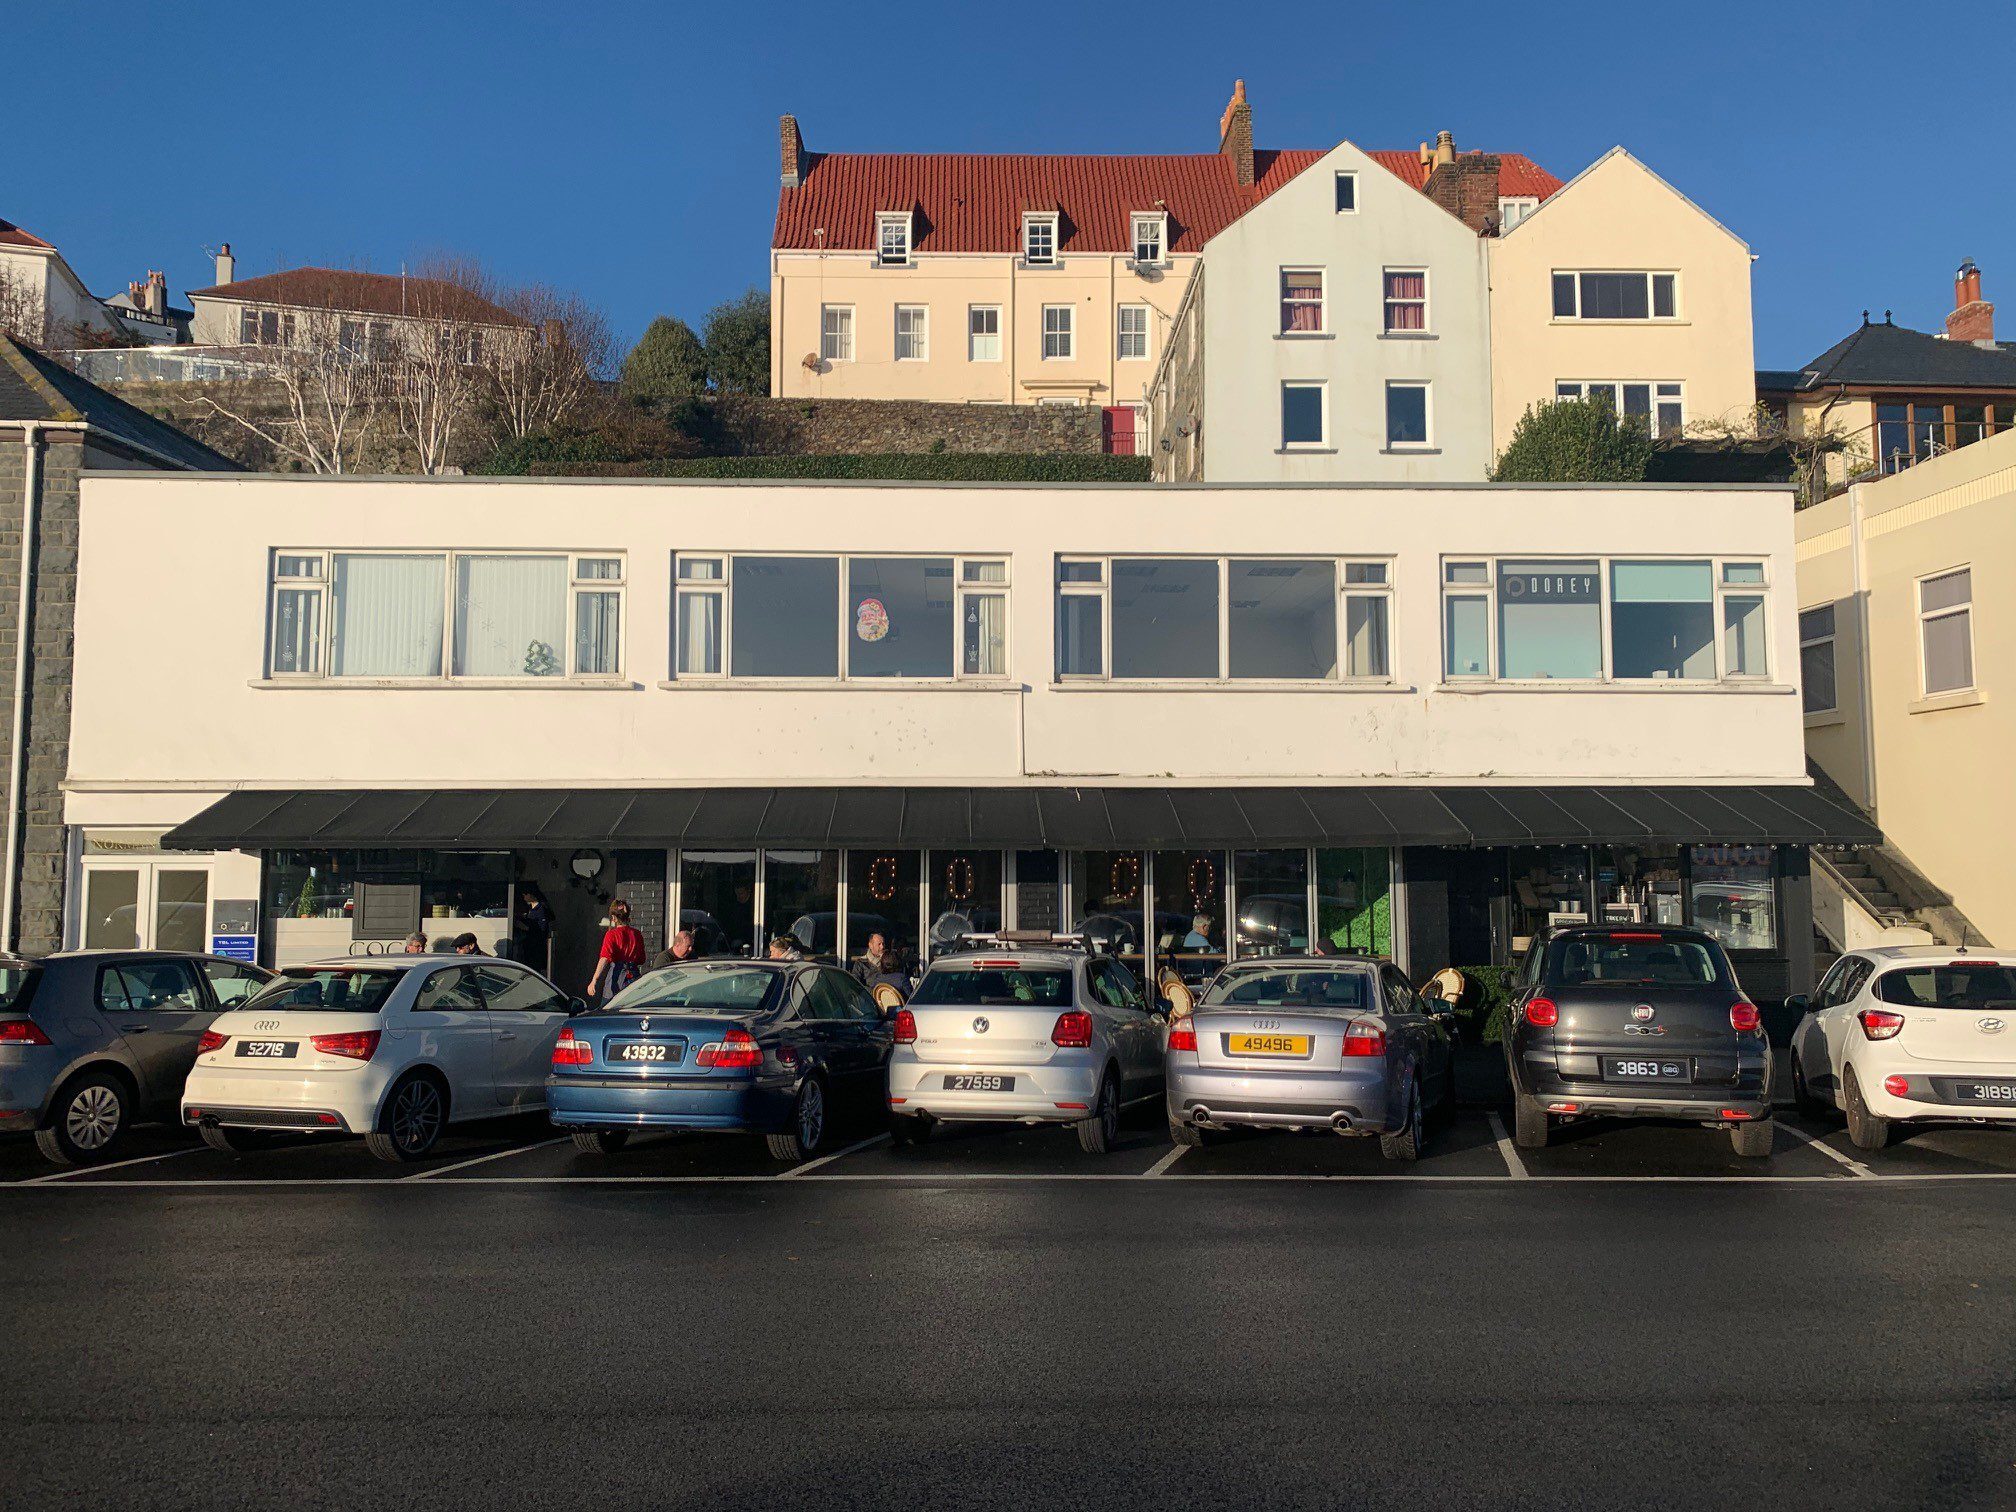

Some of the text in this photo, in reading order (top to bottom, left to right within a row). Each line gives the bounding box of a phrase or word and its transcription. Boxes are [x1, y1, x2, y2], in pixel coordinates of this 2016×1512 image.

[1531, 577, 1590, 594] DOREY
[349, 941, 408, 956] COC
[247, 1042, 285, 1056] 52719
[1243, 1037, 1292, 1051] 49496
[622, 1045, 666, 1060] 43932
[1616, 1061, 1659, 1075] 3863
[954, 1076, 1001, 1090] 27559
